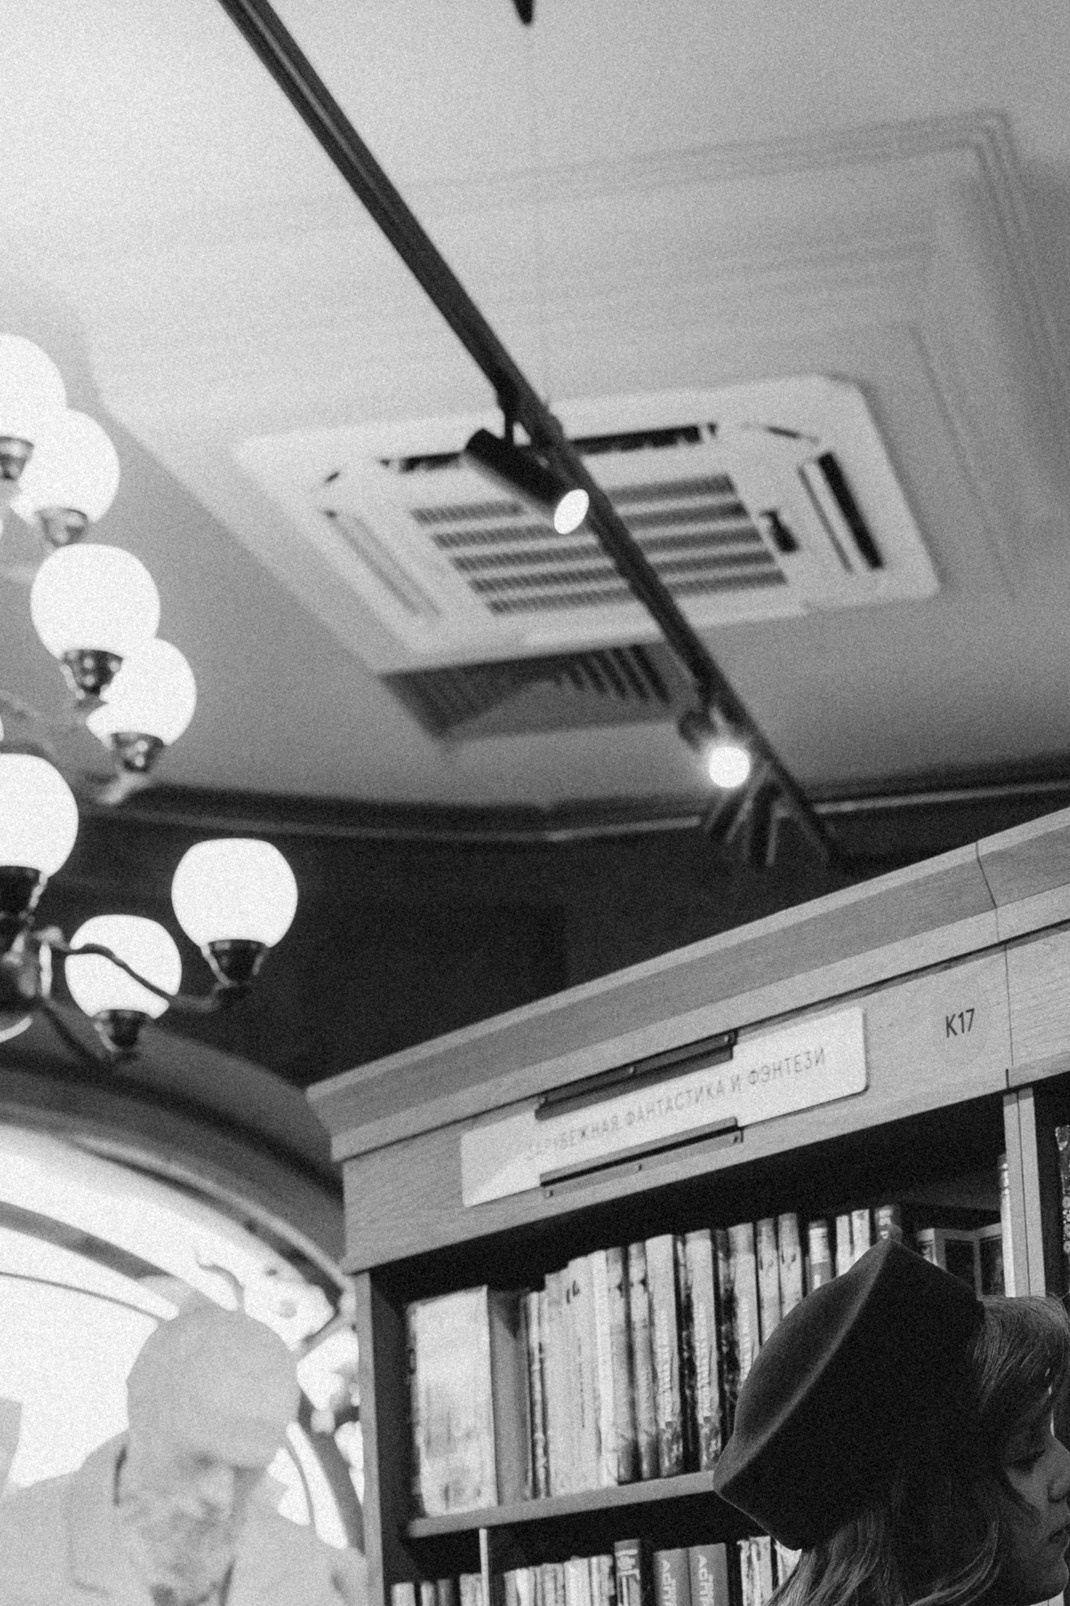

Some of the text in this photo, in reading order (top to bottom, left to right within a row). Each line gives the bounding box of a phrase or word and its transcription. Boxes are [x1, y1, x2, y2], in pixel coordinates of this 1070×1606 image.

[526, 1047, 826, 1161] ЗАРУБЕЖНАЯ ФАНТАСТИКА И ФЭНТЕЗИ
